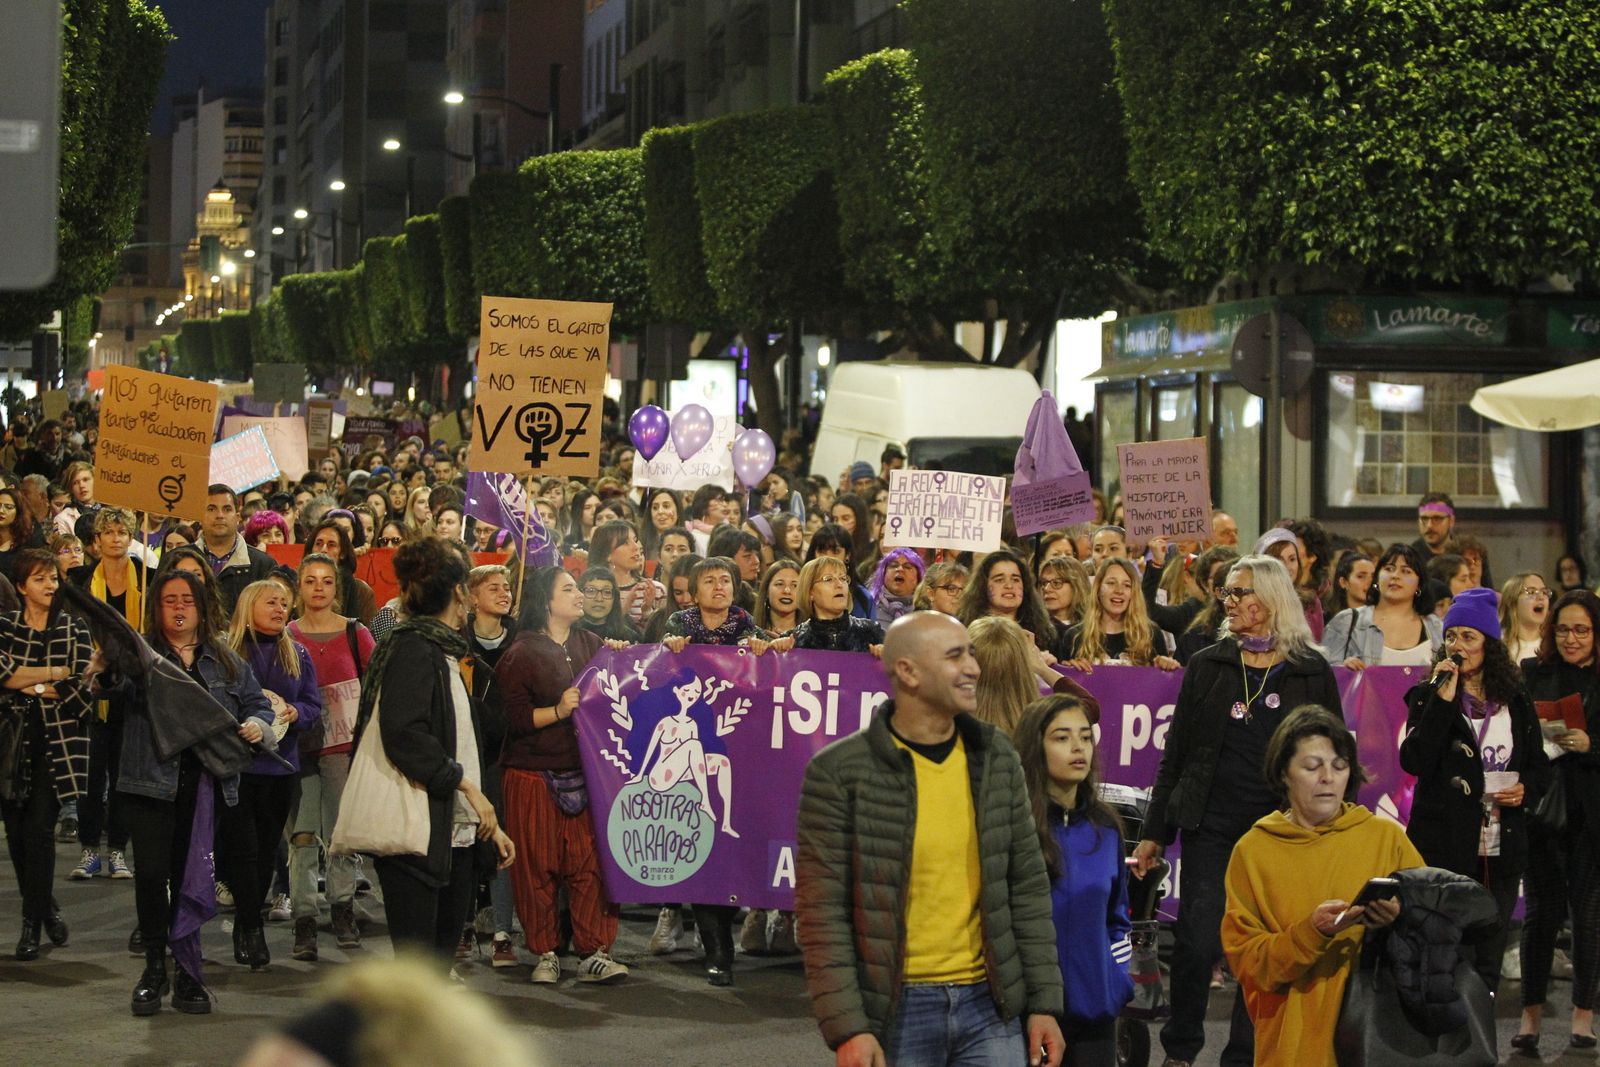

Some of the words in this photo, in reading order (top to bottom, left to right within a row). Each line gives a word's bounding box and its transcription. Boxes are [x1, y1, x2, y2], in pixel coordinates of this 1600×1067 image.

[489, 308, 540, 329] SOMOS
[547, 318, 565, 333] EL
[1373, 304, 1495, 338] Lamarté
[489, 342, 511, 357] DE
[519, 343, 545, 359] LAS
[549, 345, 578, 359] QUE
[583, 346, 601, 362] YA
[489, 372, 515, 391] NO
[147, 421, 207, 444] acabaron
[171, 454, 186, 469] el
[1151, 457, 1163, 467] LA
[1167, 454, 1199, 466] MAYOR
[890, 471, 908, 493] LA
[1126, 473, 1159, 484] PARTE
[1164, 472, 1180, 482] DE
[1185, 470, 1201, 482] LA
[923, 492, 1003, 523] FEMINISTA
[1182, 507, 1203, 518] ERA
[937, 516, 984, 542] SERÁ
[1134, 525, 1154, 536] UNA
[1162, 519, 1206, 536] MUJER
[621, 790, 702, 830] NOSOTRAS
[623, 824, 701, 867] PARAMOS
[640, 865, 649, 880] 8
